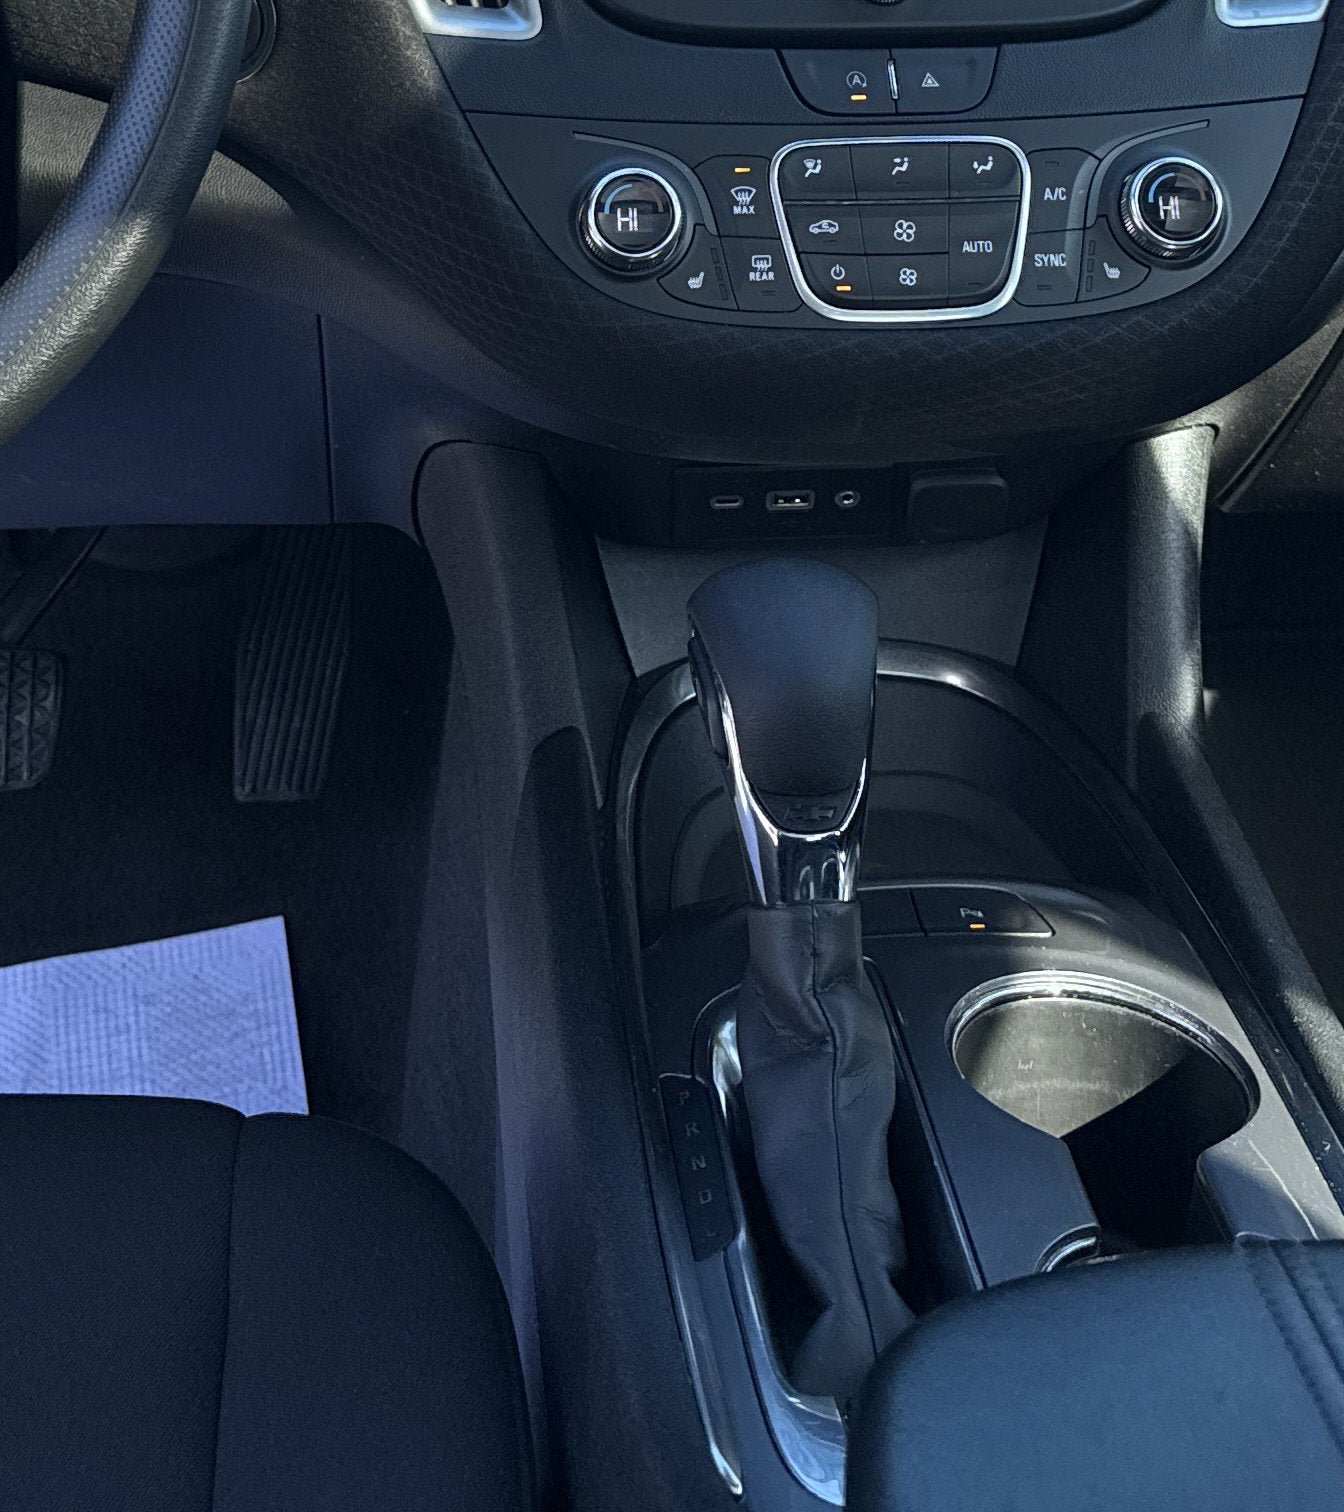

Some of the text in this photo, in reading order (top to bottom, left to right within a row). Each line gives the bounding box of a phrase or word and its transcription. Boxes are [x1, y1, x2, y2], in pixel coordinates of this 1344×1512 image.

[1043, 187, 1067, 201] A/C
[733, 205, 756, 215] MAX
[1158, 195, 1181, 220] HI
[962, 240, 993, 253] AUTO
[1034, 253, 1067, 267] SYNC
[749, 271, 775, 282] REAR
[679, 1090, 690, 1106] P
[684, 1121, 700, 1137] R
[690, 1154, 707, 1171] N
